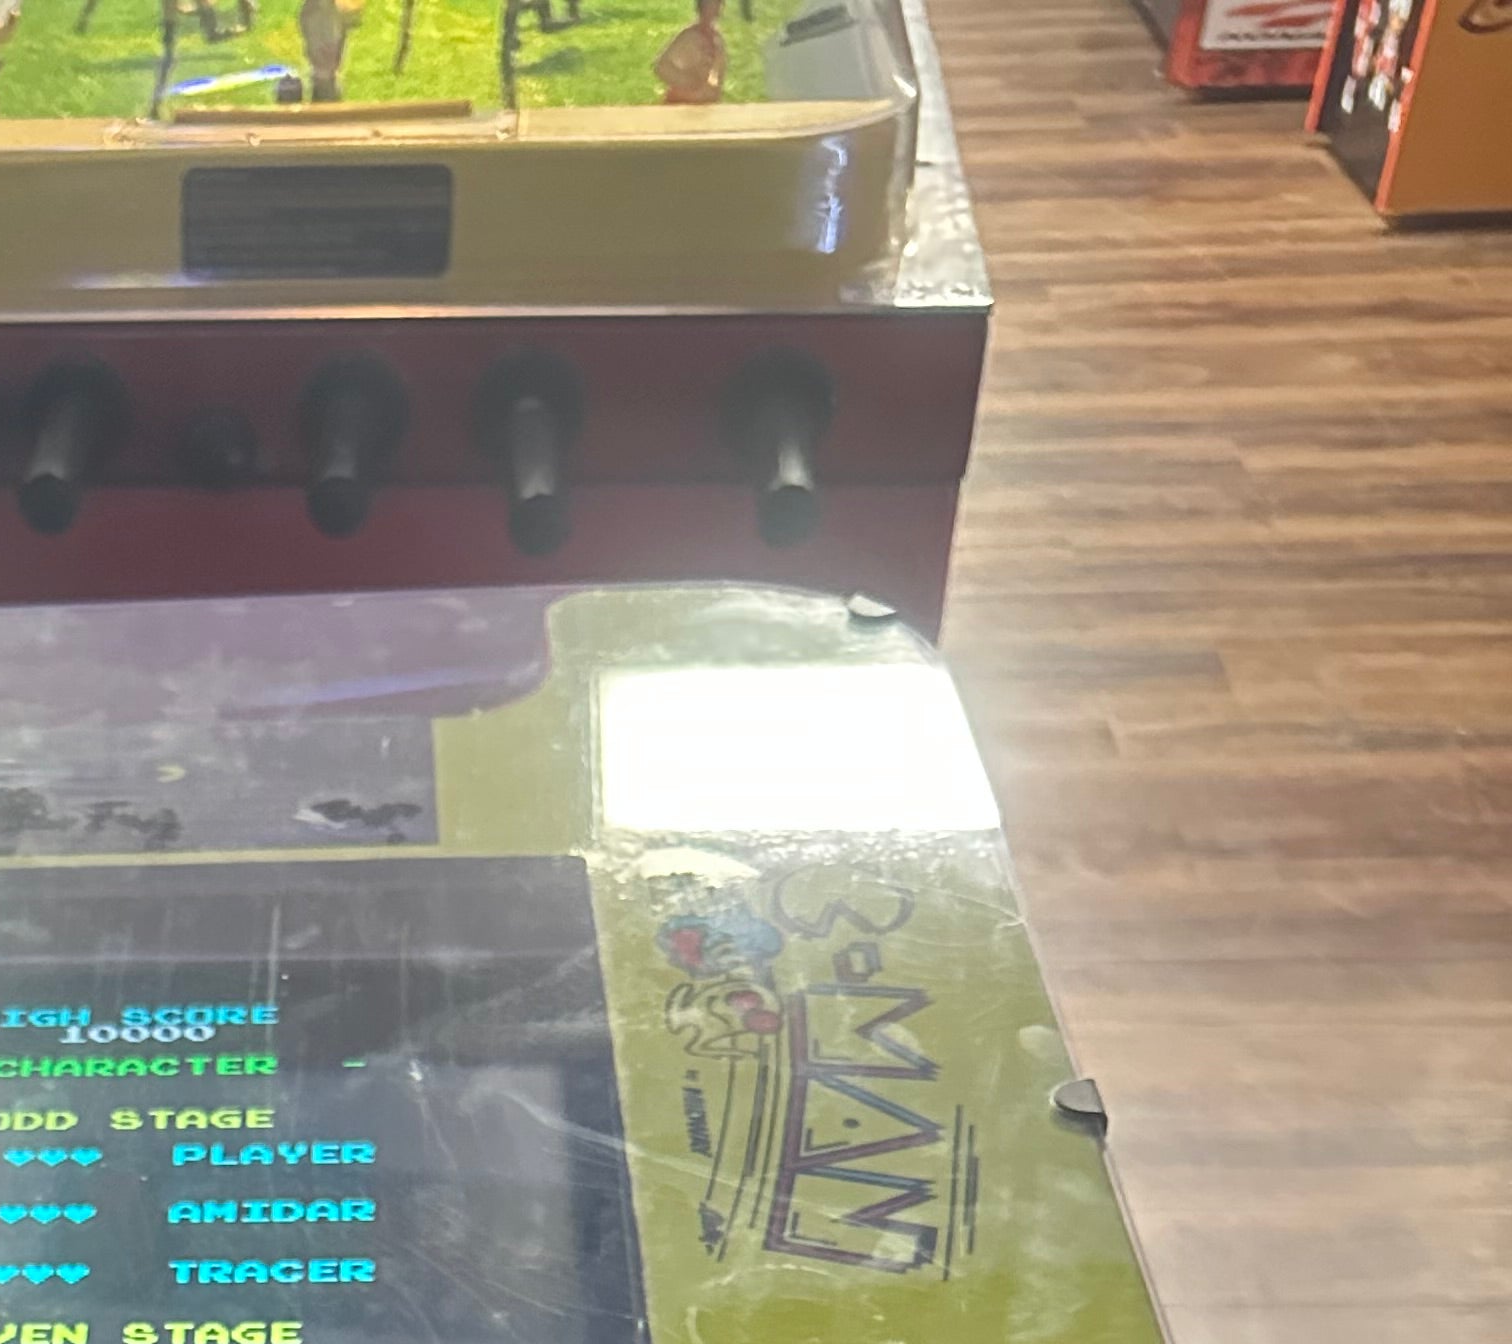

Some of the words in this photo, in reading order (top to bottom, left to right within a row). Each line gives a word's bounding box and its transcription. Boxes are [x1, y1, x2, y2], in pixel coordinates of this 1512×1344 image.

[120, 1003, 281, 1026] SCORE
[58, 1023, 217, 1045] 10000
[109, 1107, 277, 1131] STAGE
[171, 1140, 377, 1167] PLAYER
[166, 1199, 377, 1225] AMIDAR
[168, 1257, 377, 1285] TRACER
